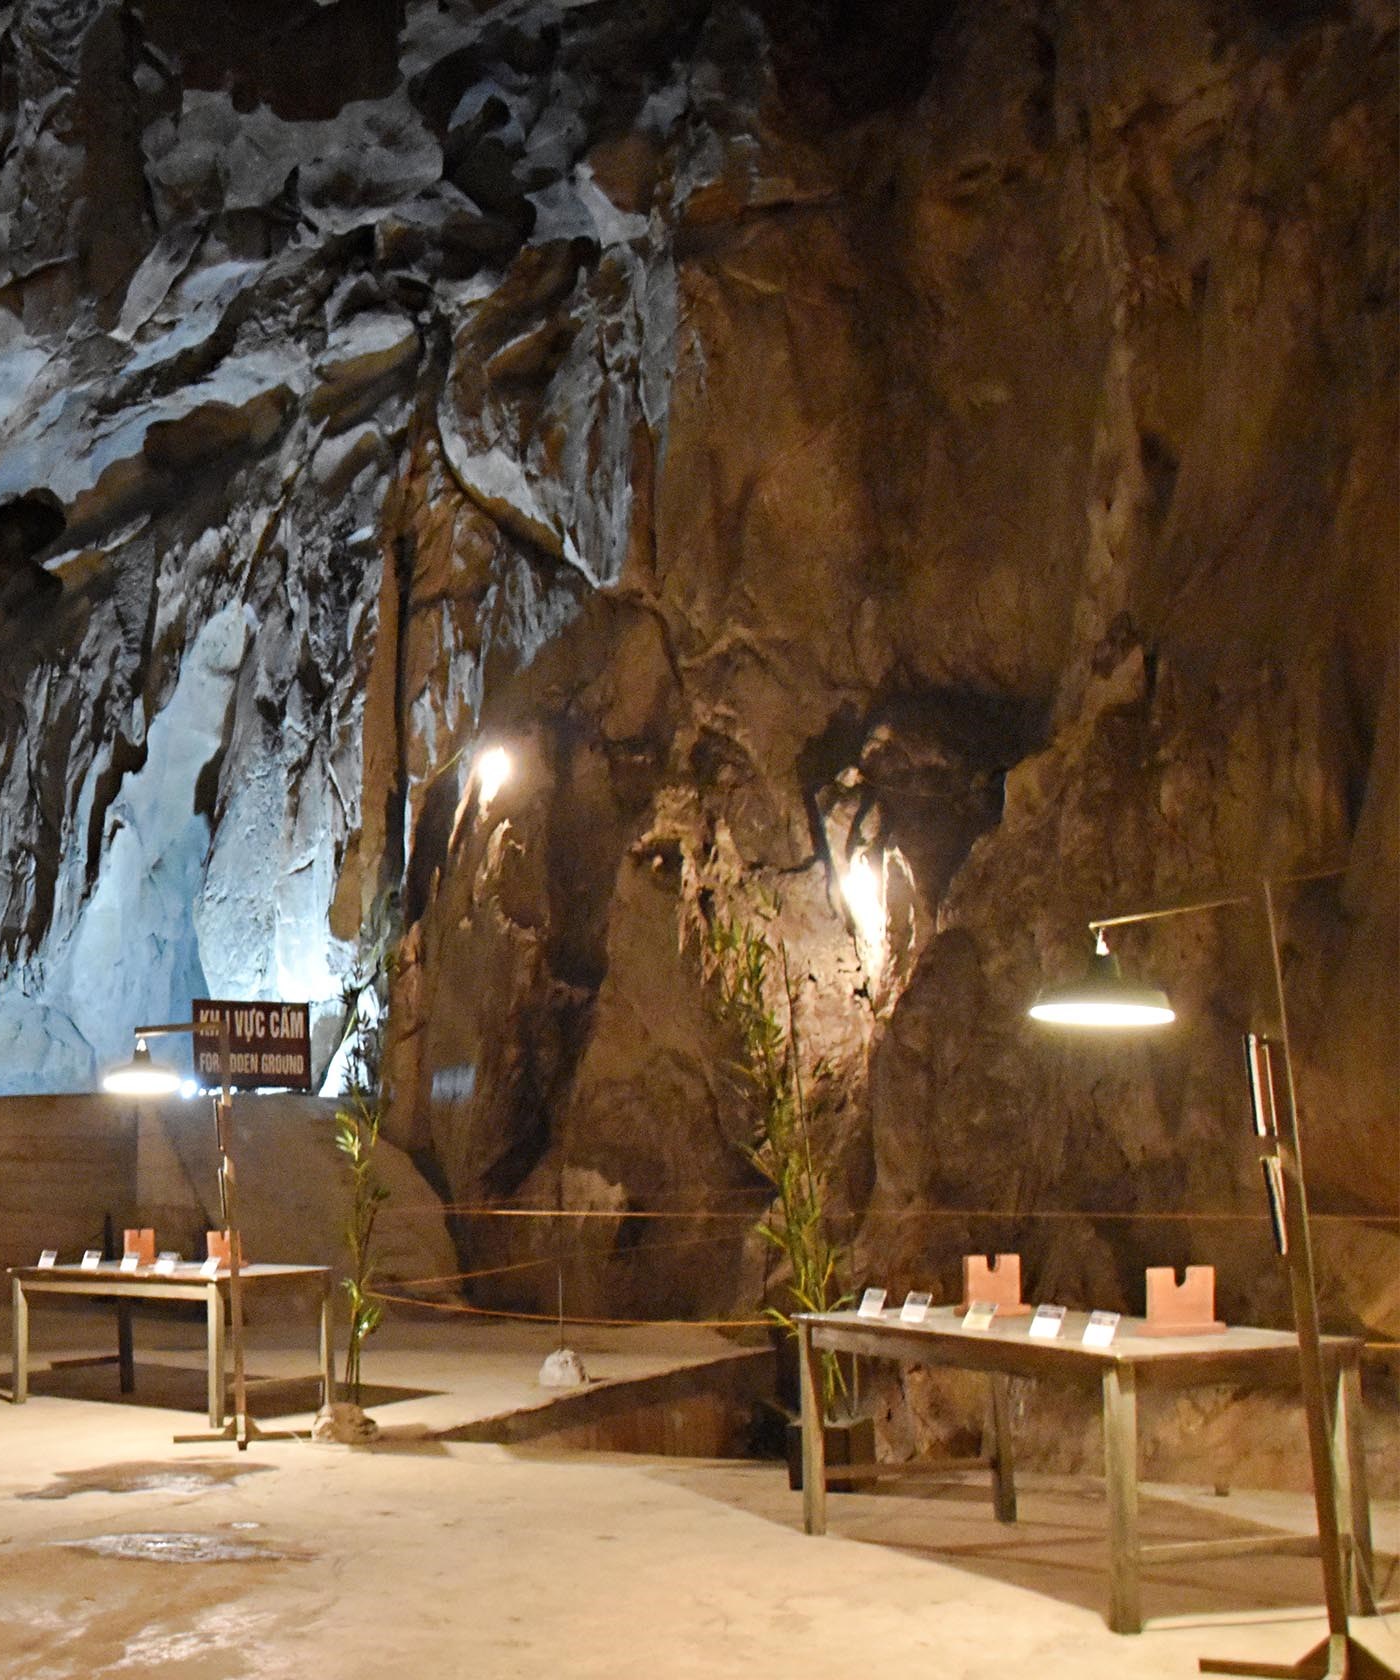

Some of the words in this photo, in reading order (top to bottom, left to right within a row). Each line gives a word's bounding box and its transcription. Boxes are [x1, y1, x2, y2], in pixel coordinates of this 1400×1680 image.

[234, 1007, 265, 1042] VỰC
[269, 1006, 304, 1039] CẤM
[200, 1052, 258, 1074] FORDDEN
[261, 1053, 304, 1075] GROUND
